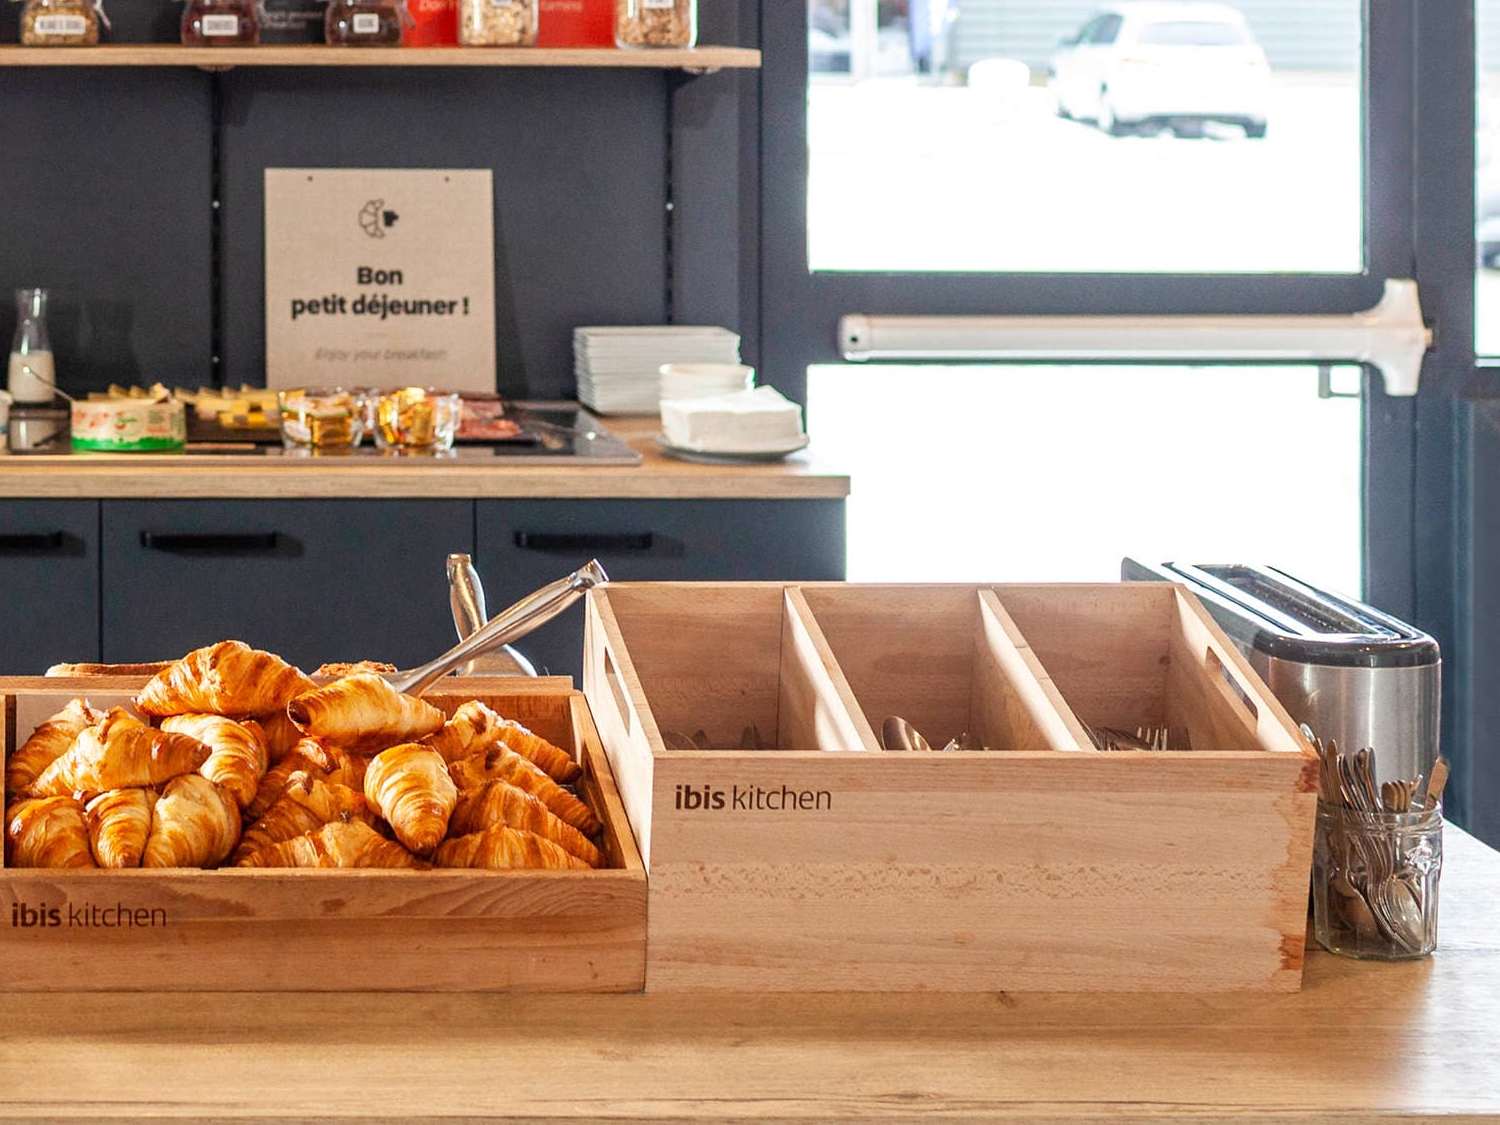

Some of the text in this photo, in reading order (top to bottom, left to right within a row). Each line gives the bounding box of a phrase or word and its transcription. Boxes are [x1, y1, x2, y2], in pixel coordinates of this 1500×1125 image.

[357, 266, 404, 286] Bon
[291, 294, 347, 321] petit
[352, 293, 458, 321] déjeuner
[675, 785, 833, 810] ibis kitchen
[11, 902, 168, 928] ibis kitchen
